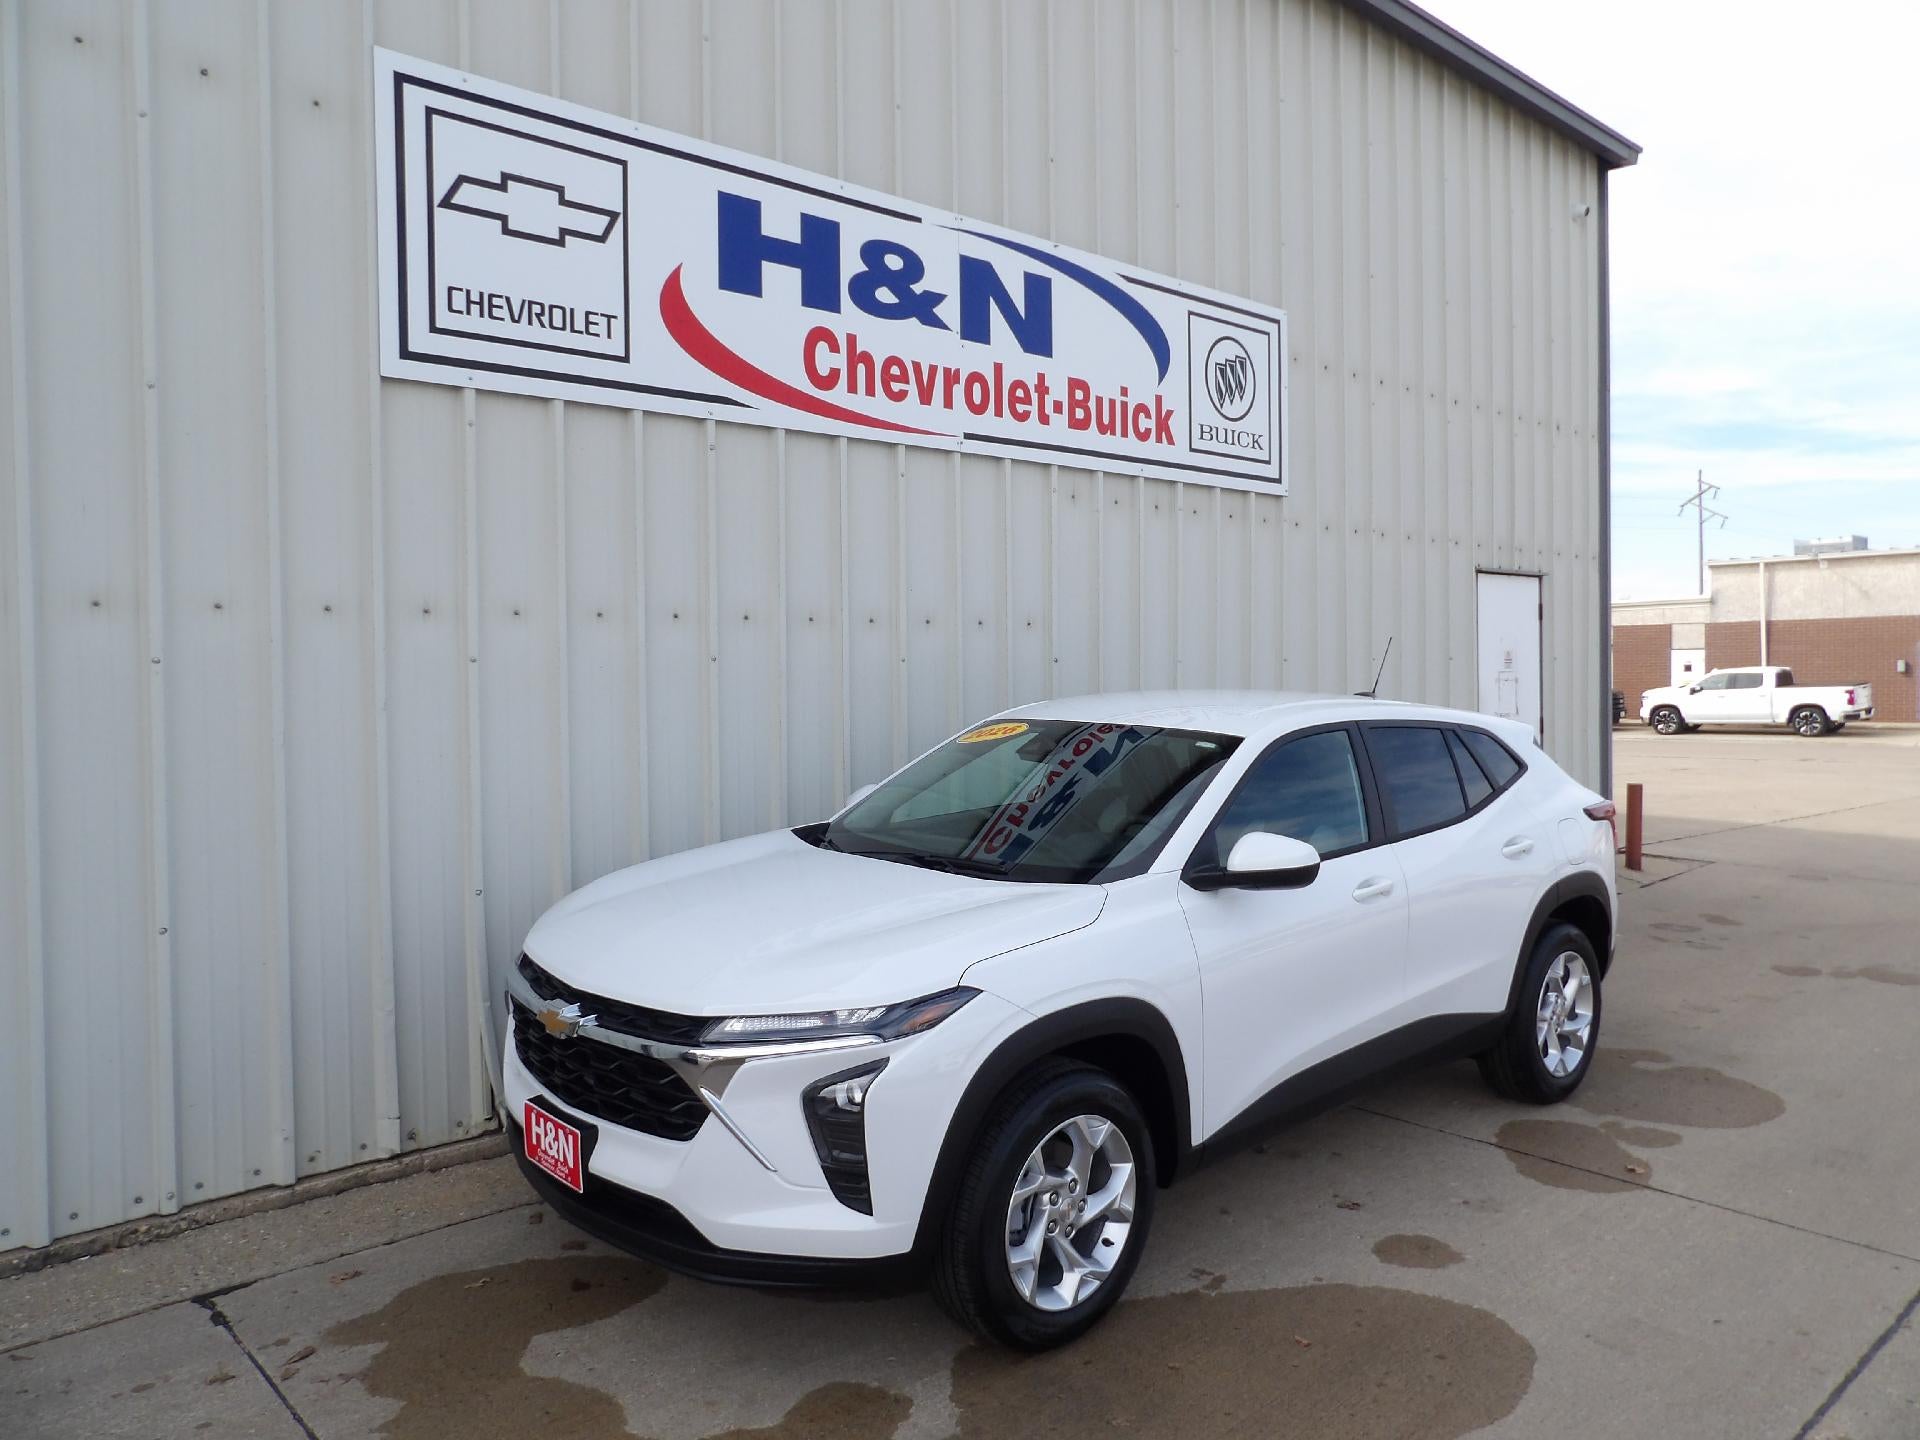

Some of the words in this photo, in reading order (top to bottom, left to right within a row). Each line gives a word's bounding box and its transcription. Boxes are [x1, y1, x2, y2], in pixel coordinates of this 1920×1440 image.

[718, 190, 1053, 358] H&N
[447, 286, 618, 340] CHEVROLET
[803, 326, 1176, 446] Chevrolet-Buick
[1198, 423, 1264, 450] BUICK
[531, 1112, 574, 1168] H&N
